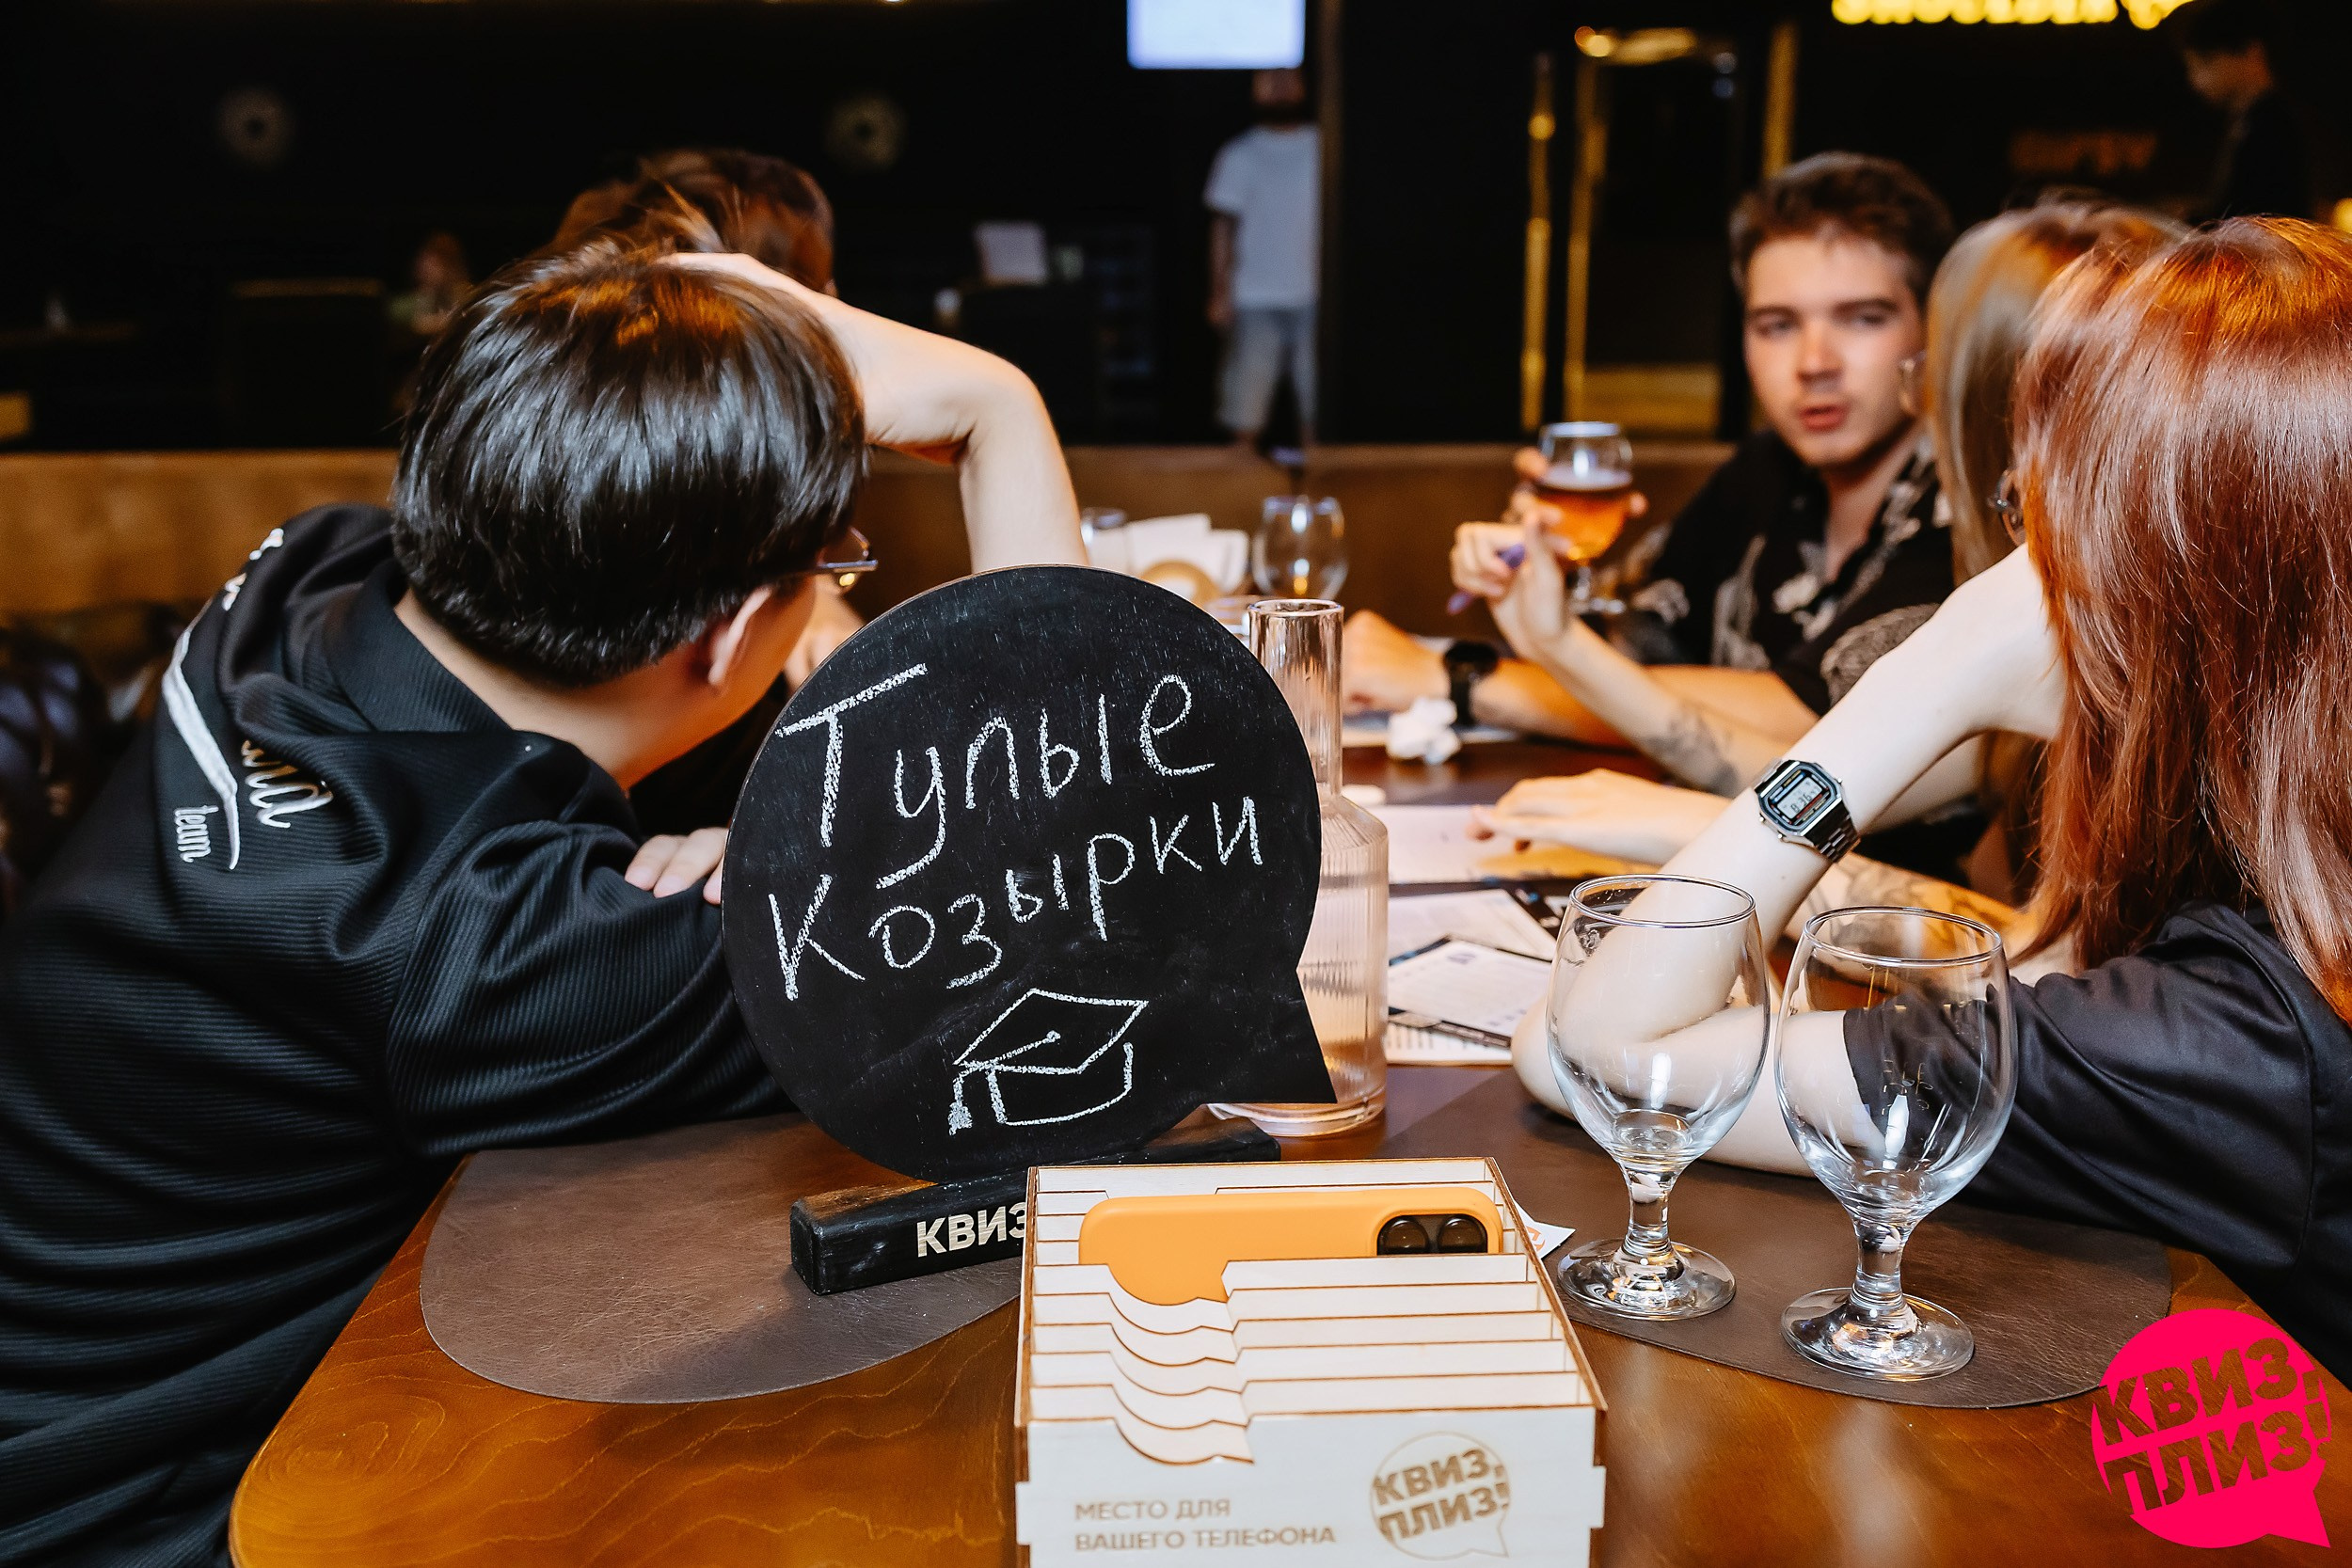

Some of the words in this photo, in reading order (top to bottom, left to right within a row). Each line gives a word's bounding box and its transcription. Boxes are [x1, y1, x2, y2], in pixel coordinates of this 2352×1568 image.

[774, 662, 1216, 890] Тупые
[174, 804, 219, 863] team
[768, 796, 1263, 1000] Козырки
[1074, 1499, 1169, 1521] МЕСТО
[1175, 1497, 1232, 1521] ДЛЯ
[1074, 1530, 1185, 1552] ВАШЕГО
[1195, 1525, 1337, 1548] ТЕЛЕФОНА
[1379, 1481, 1510, 1544] ПЛИЗ!
